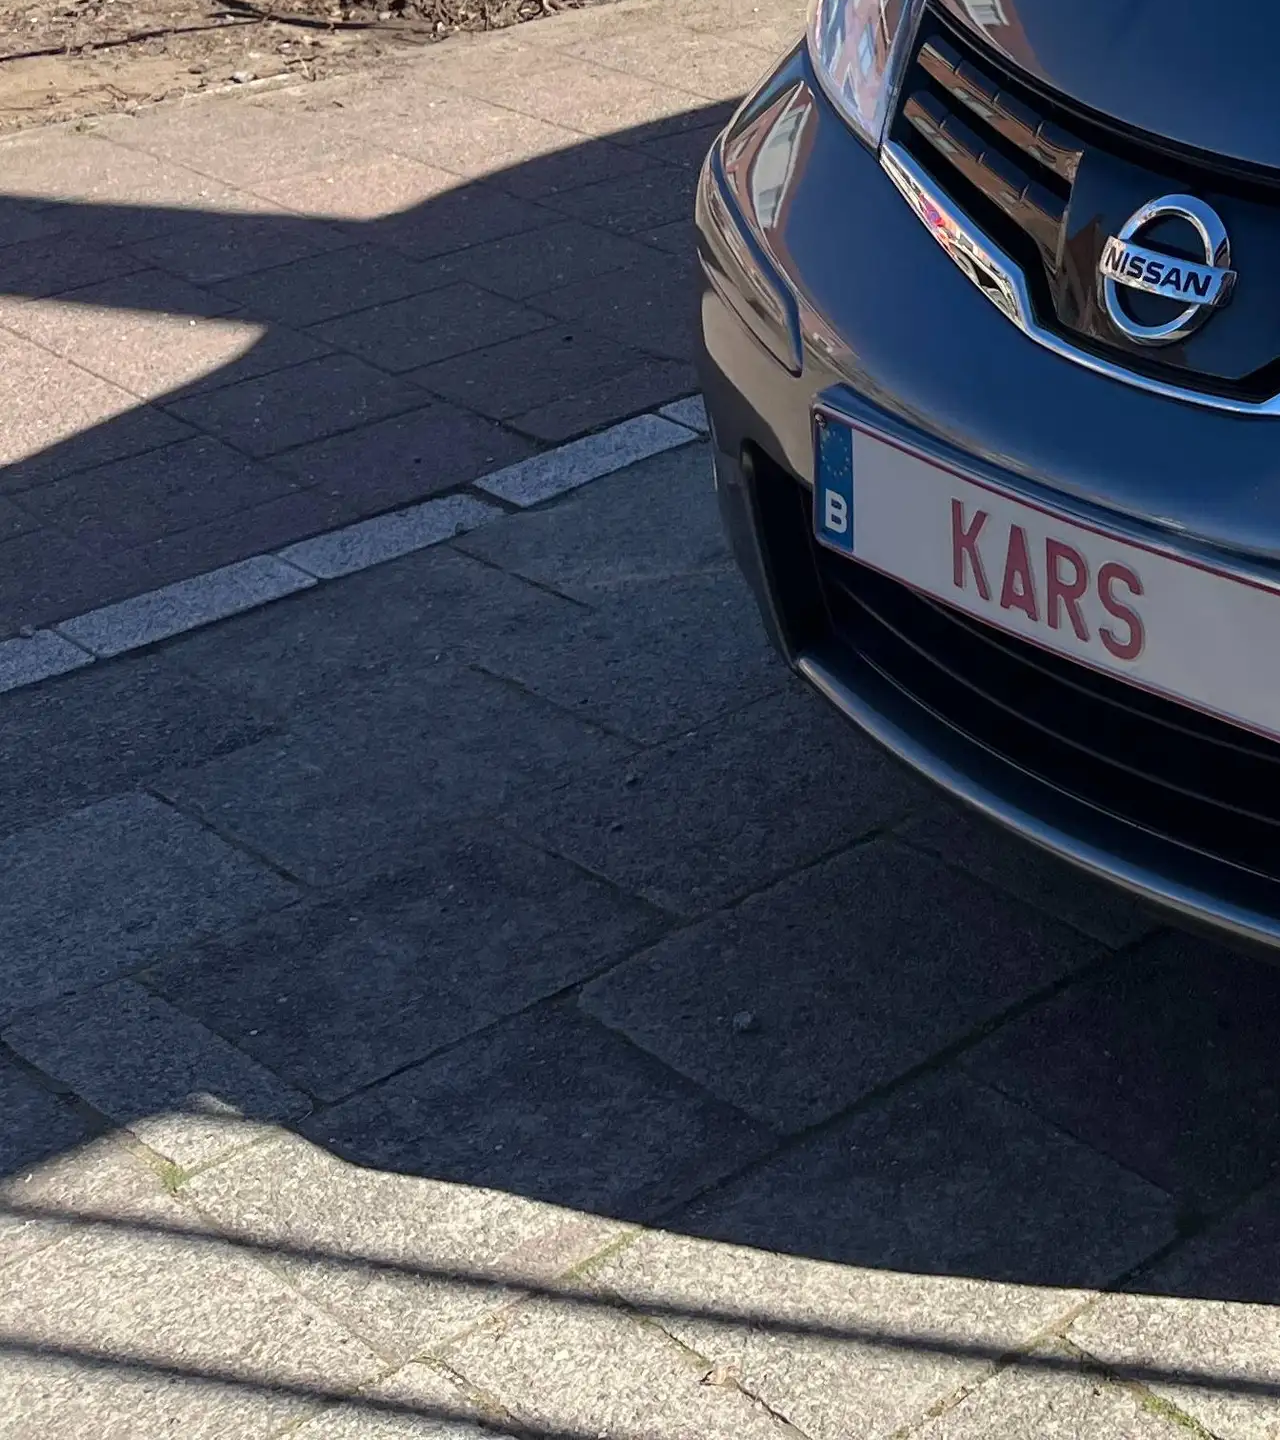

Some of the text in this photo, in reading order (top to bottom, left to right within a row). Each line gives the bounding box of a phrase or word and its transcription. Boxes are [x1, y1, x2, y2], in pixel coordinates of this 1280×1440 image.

[1105, 245, 1212, 297] NISSAN
[825, 488, 848, 533] B
[951, 498, 1145, 661] KARS
